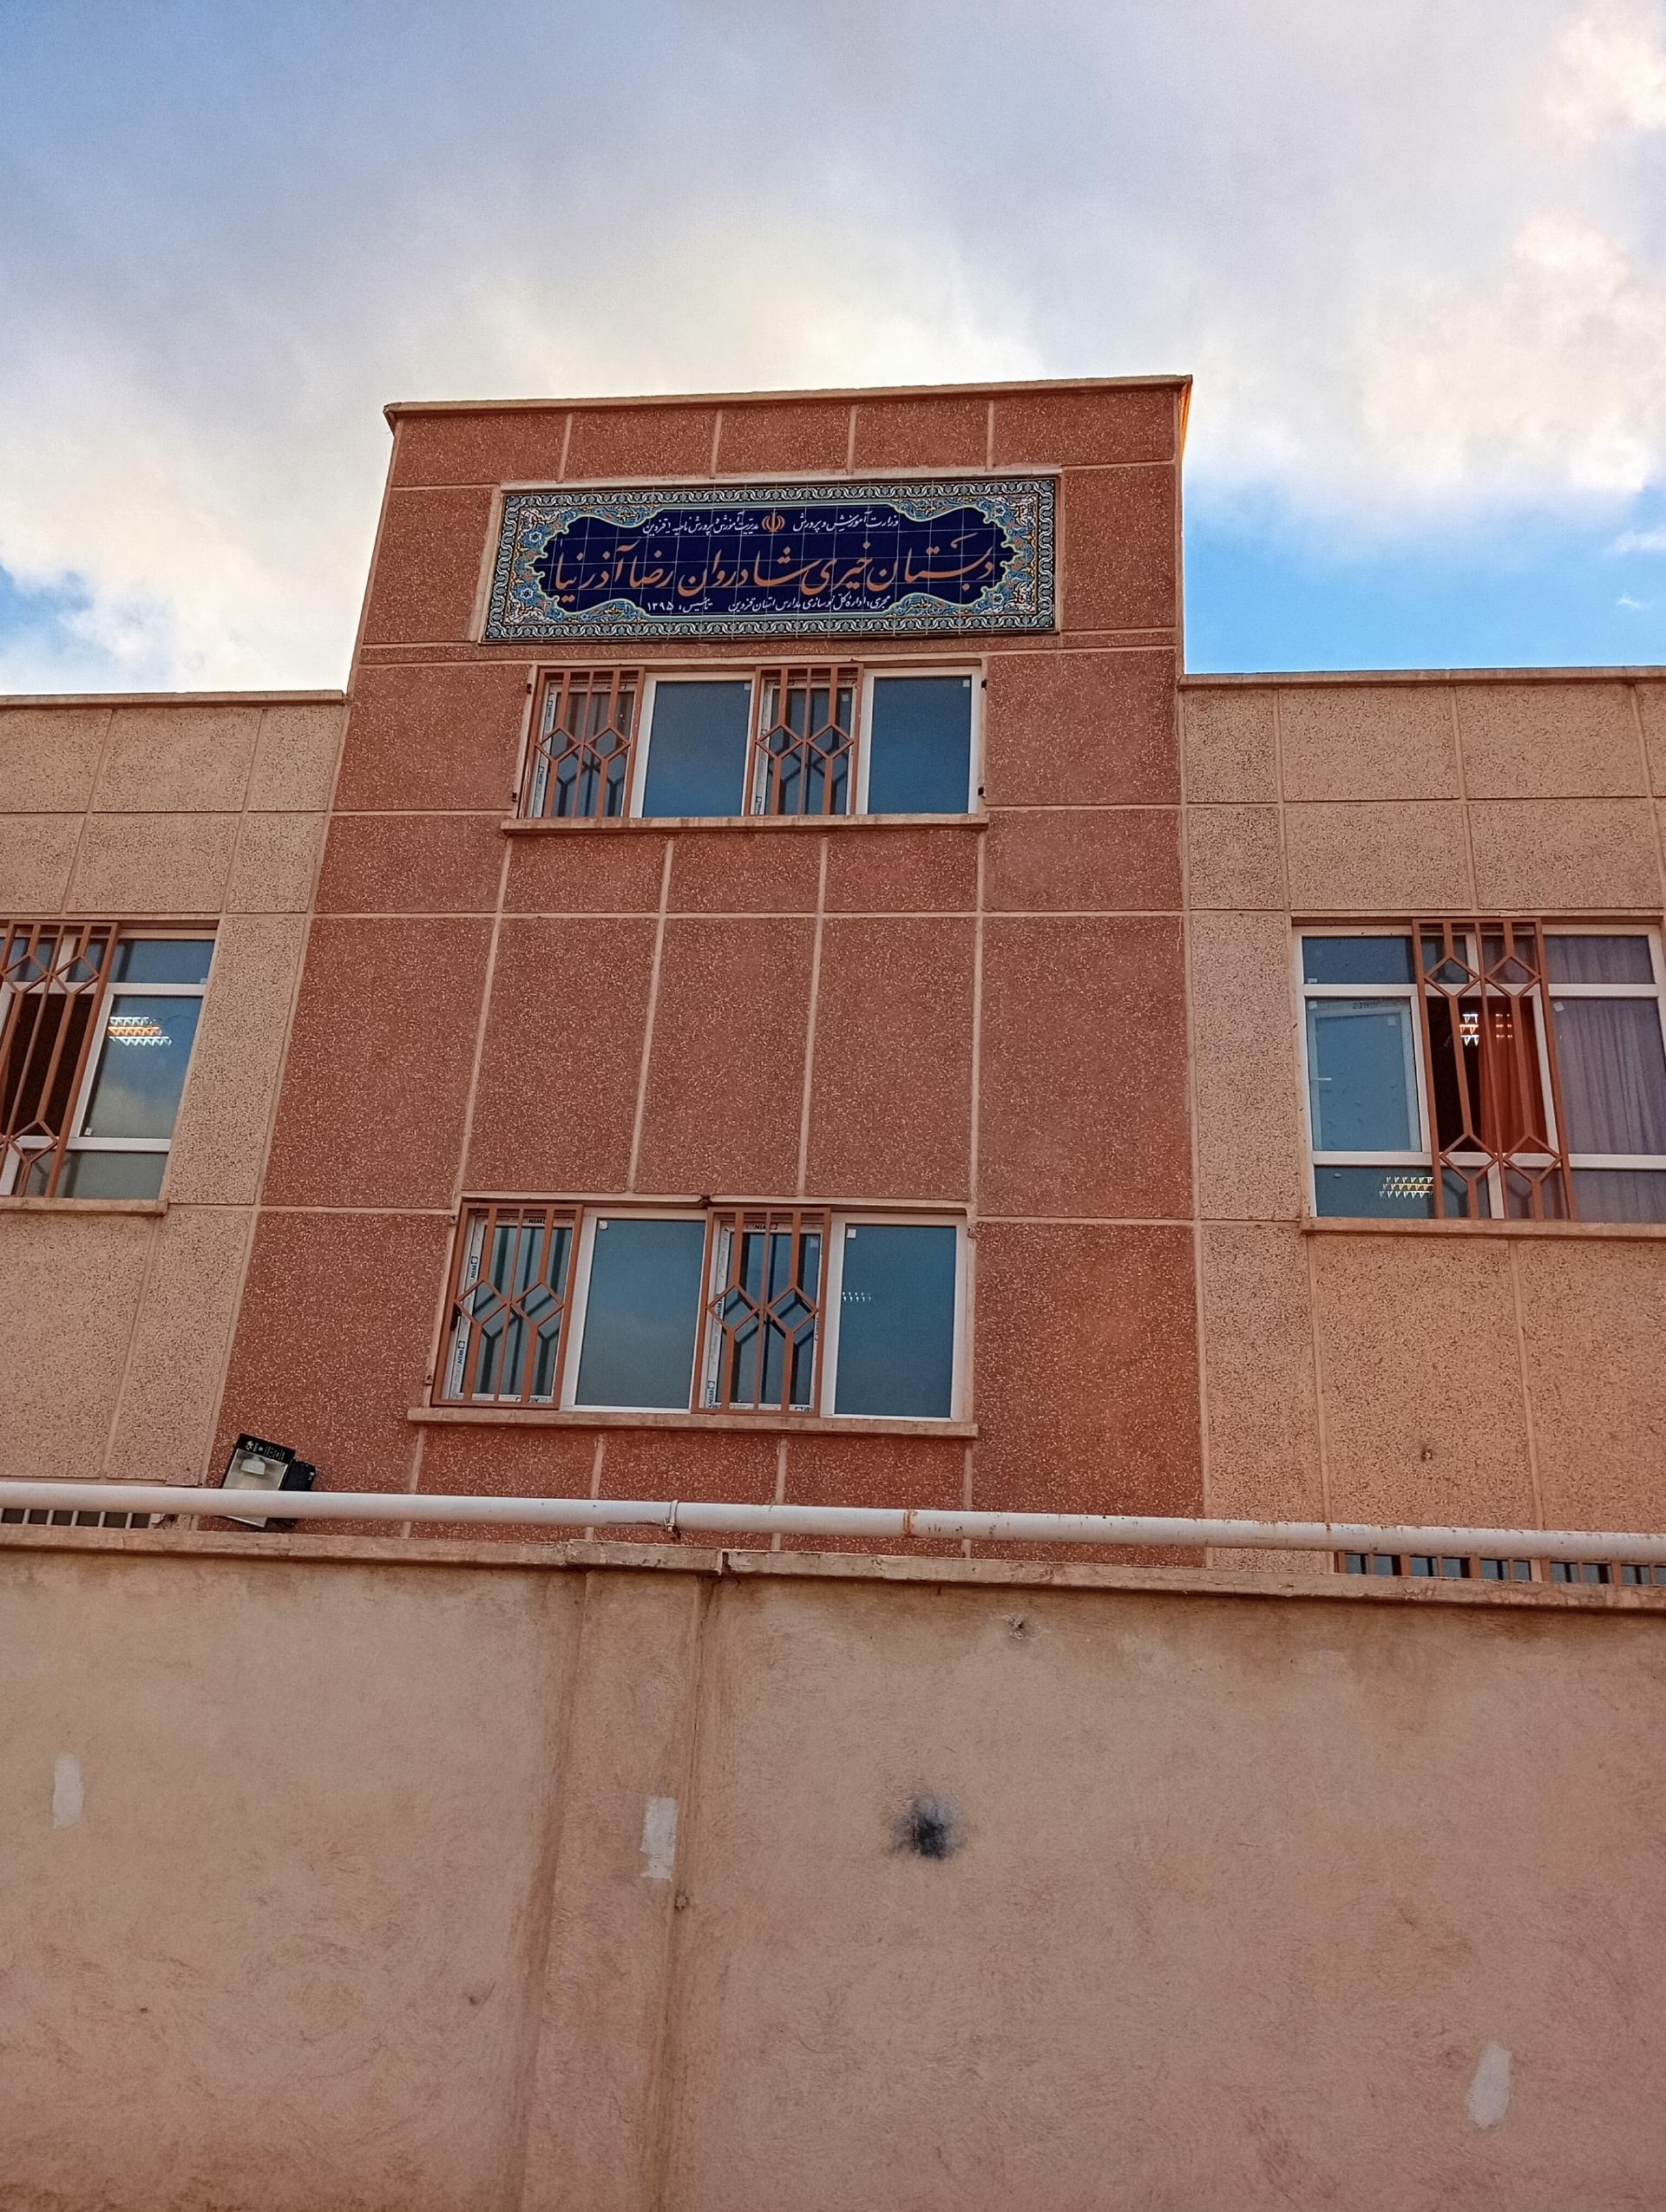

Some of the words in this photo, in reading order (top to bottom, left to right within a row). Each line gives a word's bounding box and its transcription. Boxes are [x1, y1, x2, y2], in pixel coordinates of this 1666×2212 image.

[642, 518, 668, 536] قزوین
[688, 515, 714, 536] پرورش
[792, 512, 822, 533] پرورش
[826, 510, 873, 532] آموزش
[865, 514, 899, 527] وزارت
[628, 549, 674, 589] رضا
[678, 546, 823, 597] شادروان
[647, 600, 674, 612] ۱۳۹۵
[728, 597, 757, 612] قزوین
[751, 595, 777, 612] استان
[776, 597, 801, 611] مدارس
